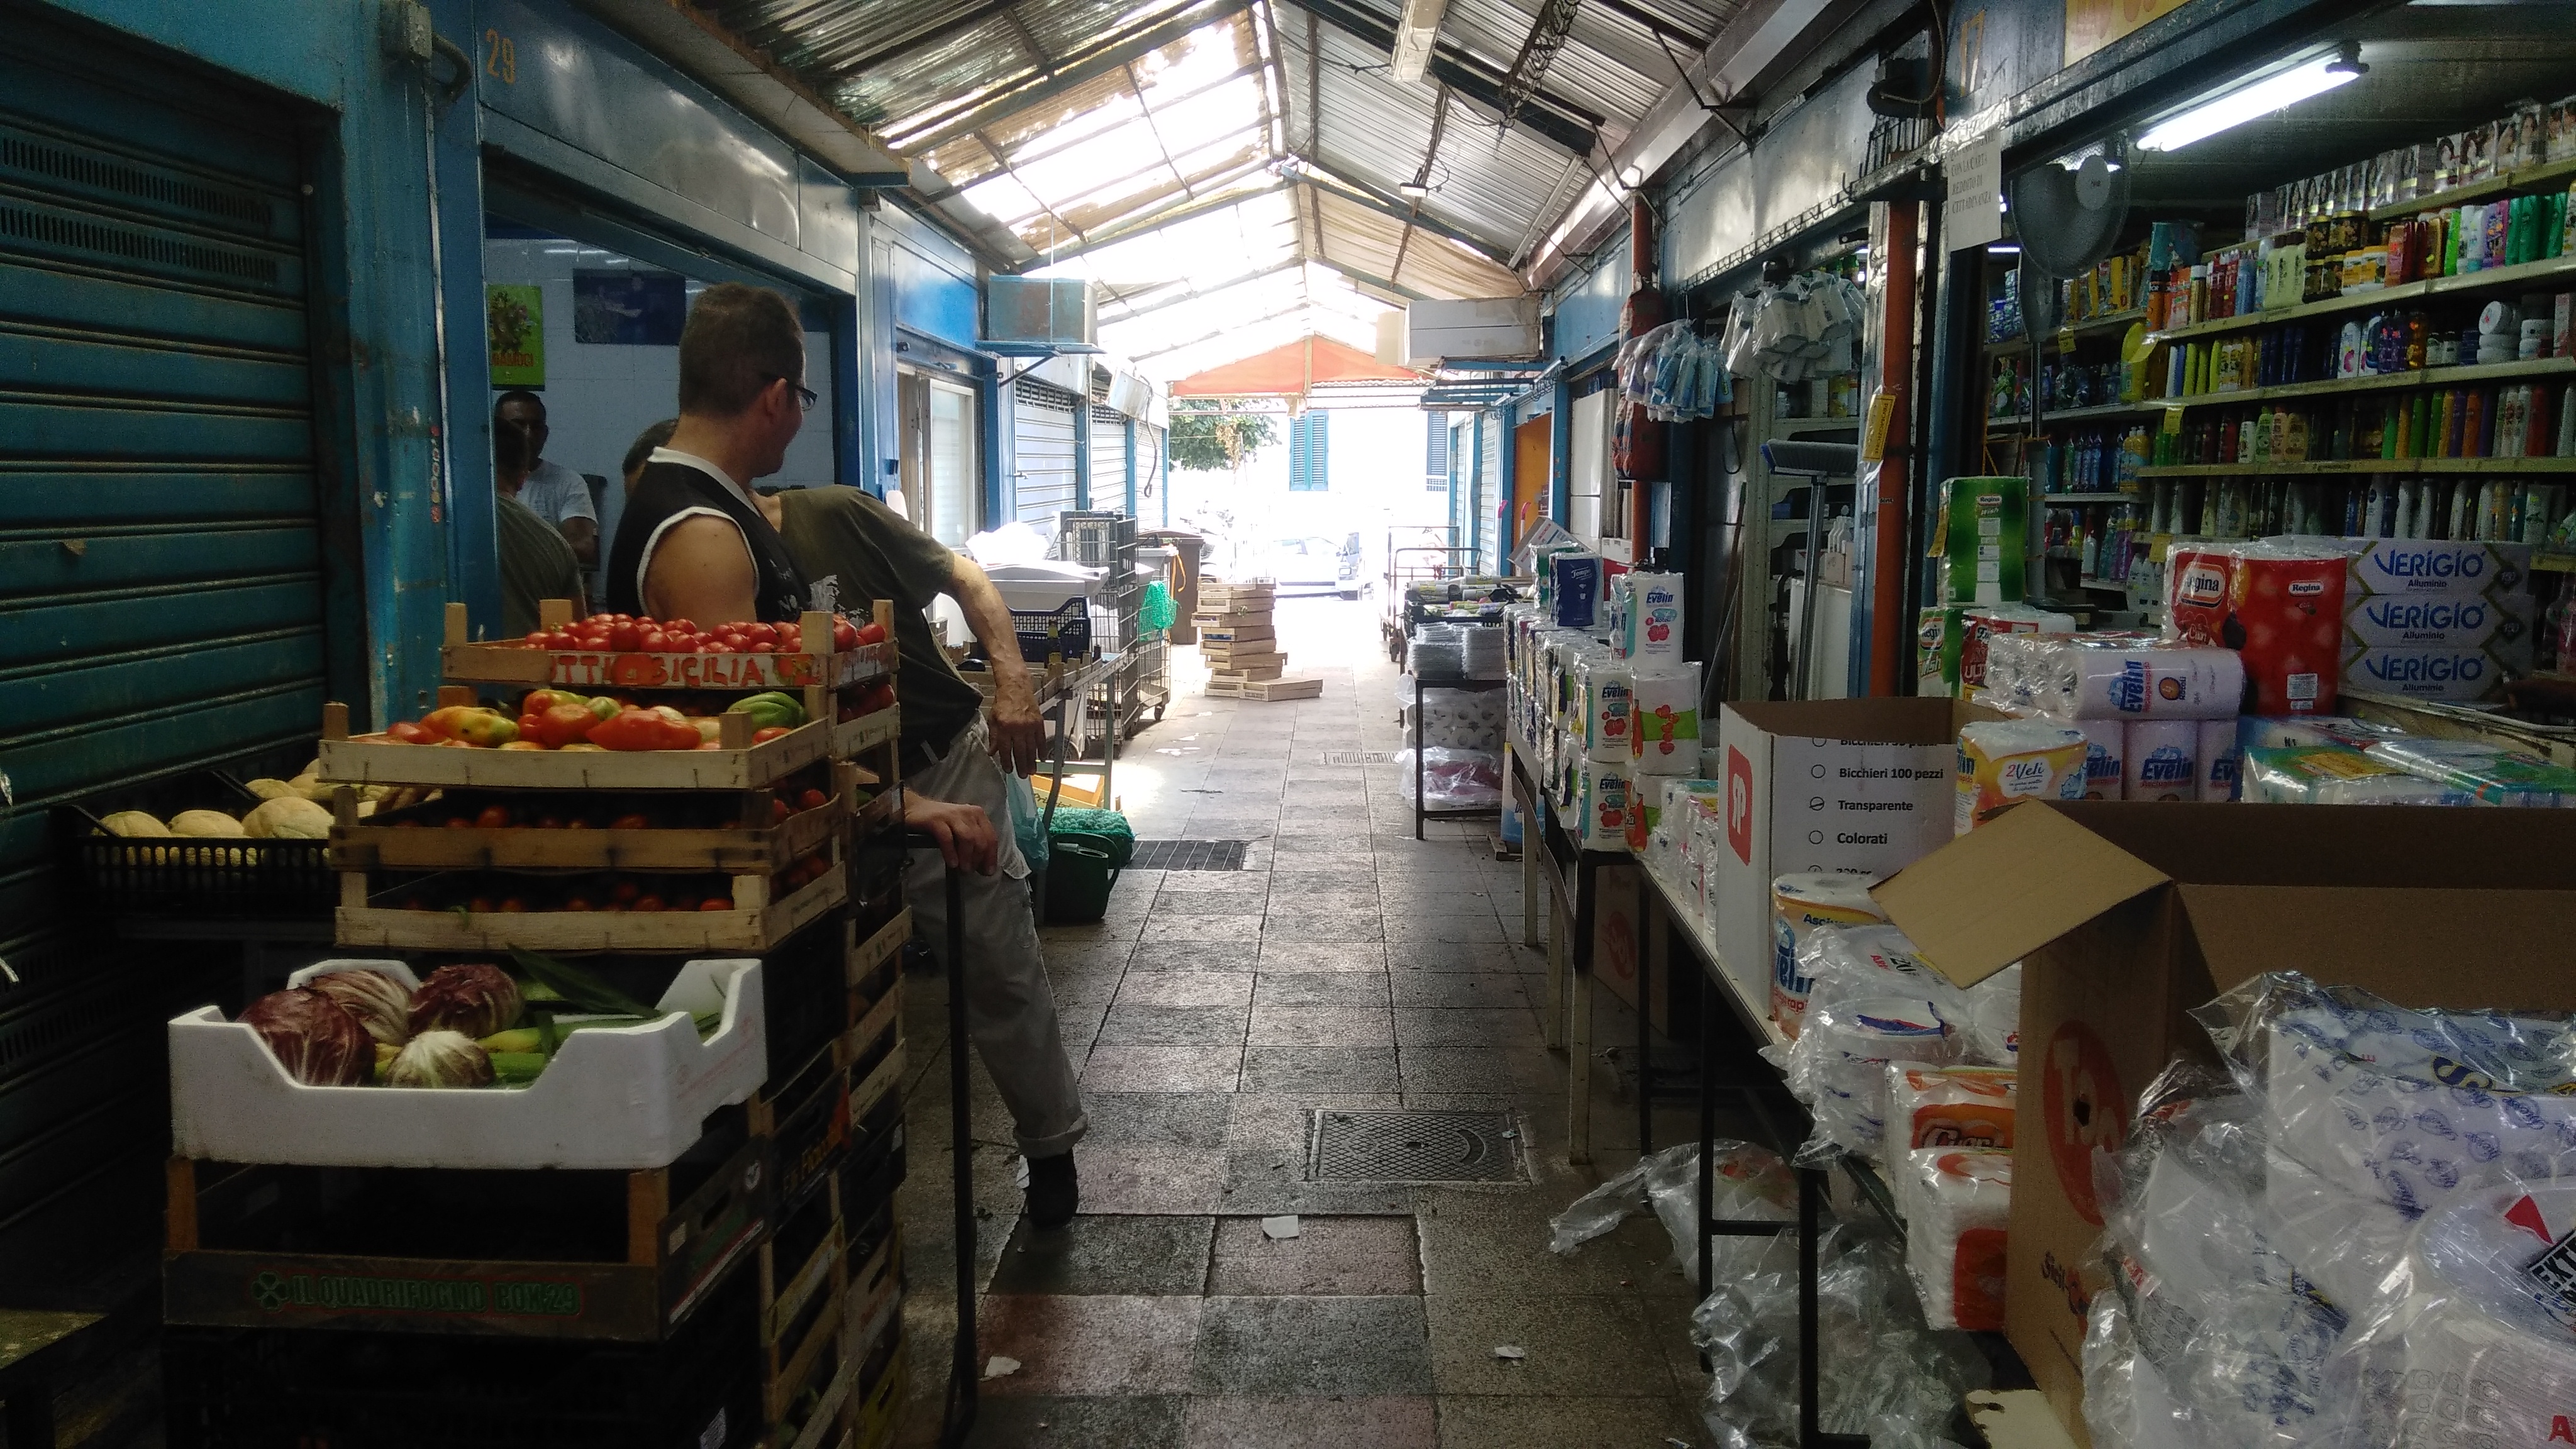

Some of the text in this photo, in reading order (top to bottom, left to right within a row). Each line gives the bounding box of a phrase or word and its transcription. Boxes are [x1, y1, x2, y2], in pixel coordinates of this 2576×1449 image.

[485, 28, 516, 85] 29
[1951, 177, 1976, 196] REDDITO
[1952, 191, 1991, 214] CITTADINANZA
[1571, 567, 1592, 579] Tempo
[2292, 584, 2321, 592] Regina
[2407, 579, 2447, 587] Alluminio
[1646, 592, 1674, 604] Evelin
[2402, 631, 2446, 640] Alluminio
[652, 655, 766, 687] SICILIA
[2119, 659, 2144, 713] Evelin
[2402, 684, 2445, 692] Alluminio
[1602, 687, 1629, 698] Evelin
[1839, 768, 1943, 780] Bicchieri 100 pezzi
[2141, 757, 2194, 780] Evelin
[1838, 800, 1913, 812] Transparente
[1837, 832, 1888, 845] Colorati
[318, 1275, 487, 1313] QUADRIFOGLIO
